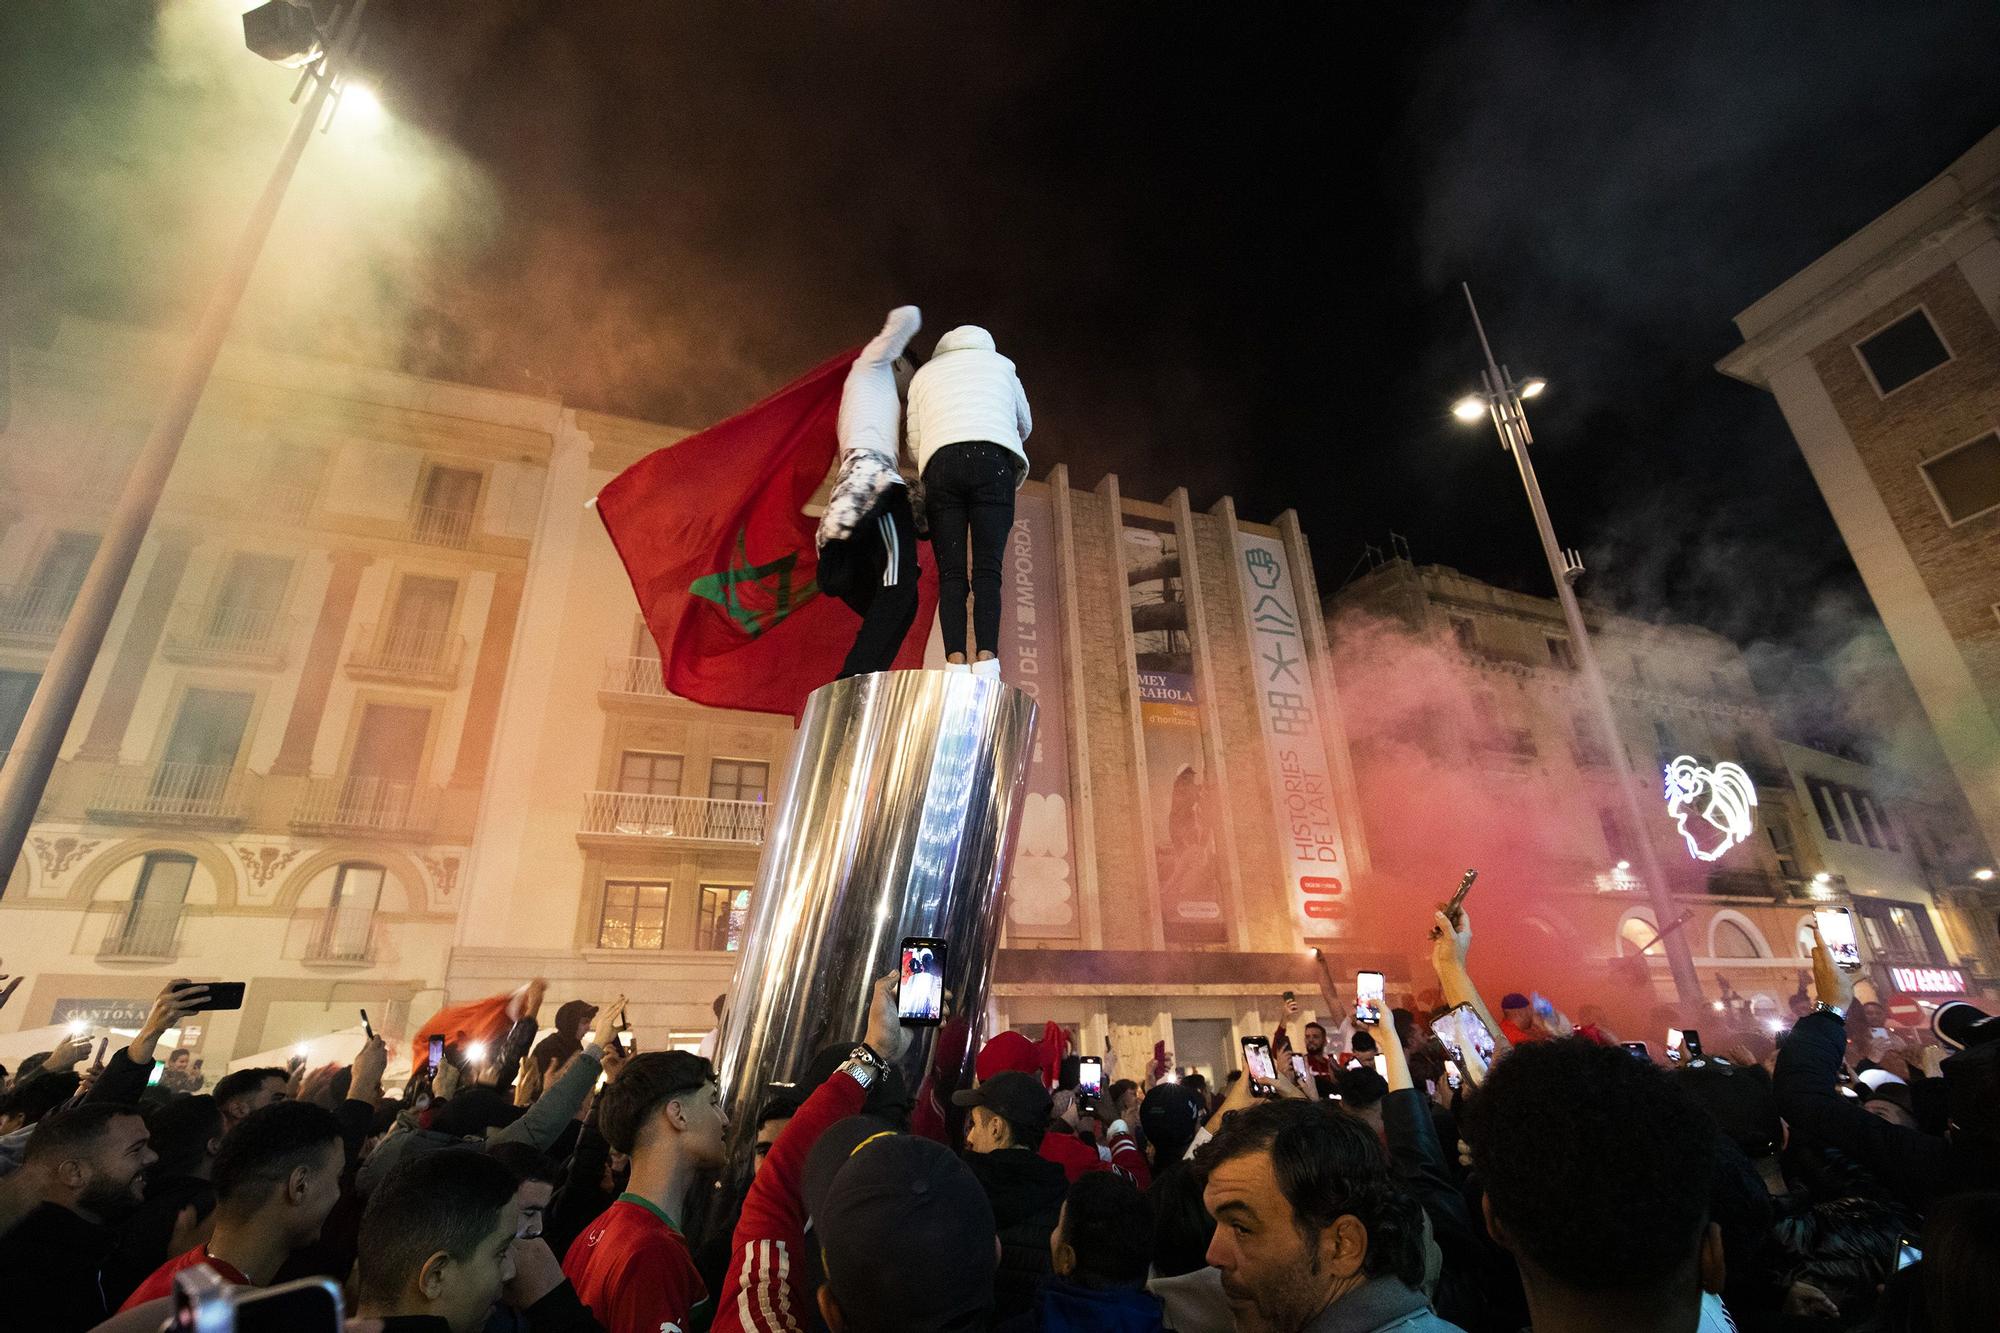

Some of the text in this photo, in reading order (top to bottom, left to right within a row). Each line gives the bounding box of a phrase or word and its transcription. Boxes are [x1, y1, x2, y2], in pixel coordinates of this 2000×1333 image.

[1019, 646, 1039, 674] DE
[1302, 769, 1331, 826] L'ART
[1315, 834, 1337, 862] DE
[66, 1009, 146, 1020] CANTONA
